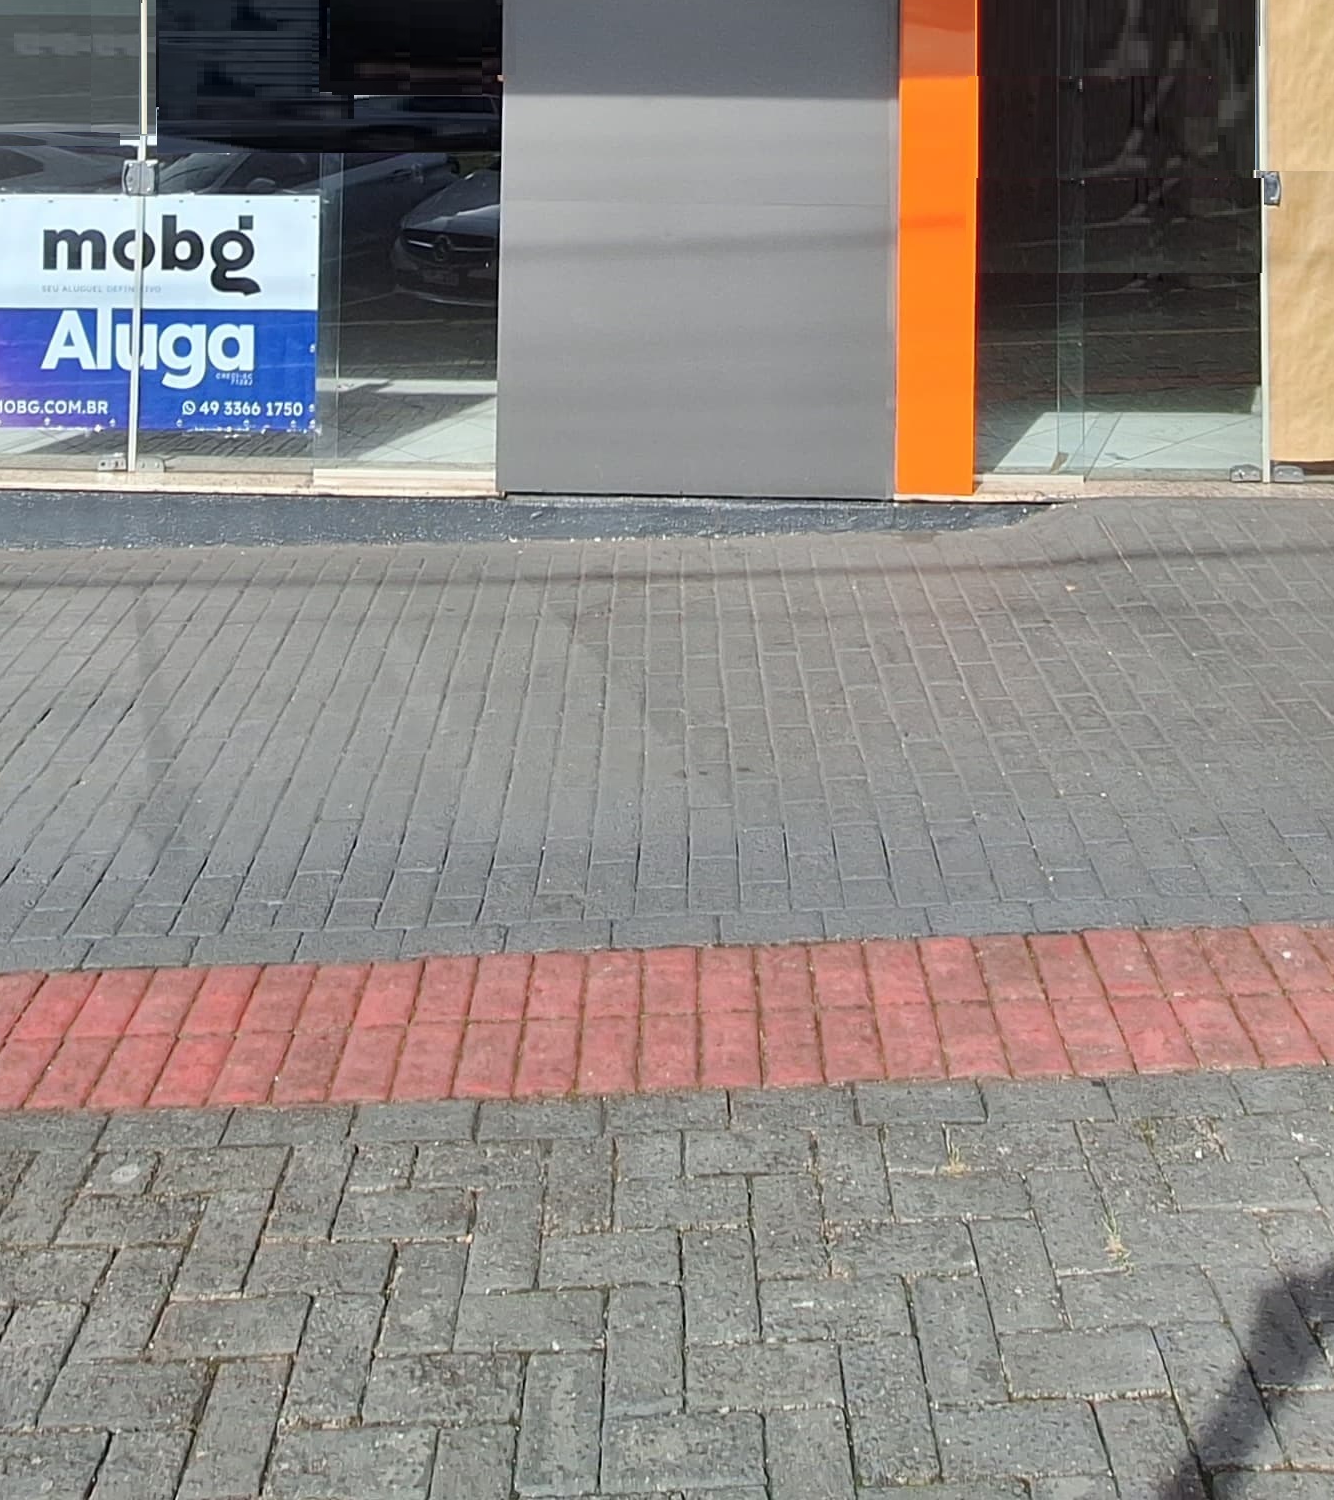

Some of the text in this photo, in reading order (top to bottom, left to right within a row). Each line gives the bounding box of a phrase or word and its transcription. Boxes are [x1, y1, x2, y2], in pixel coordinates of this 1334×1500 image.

[43, 214, 261, 296] mobg
[41, 308, 255, 389] Aluga
[199, 402, 220, 416] 49
[223, 402, 261, 416] 3366
[266, 402, 304, 417] 1750
